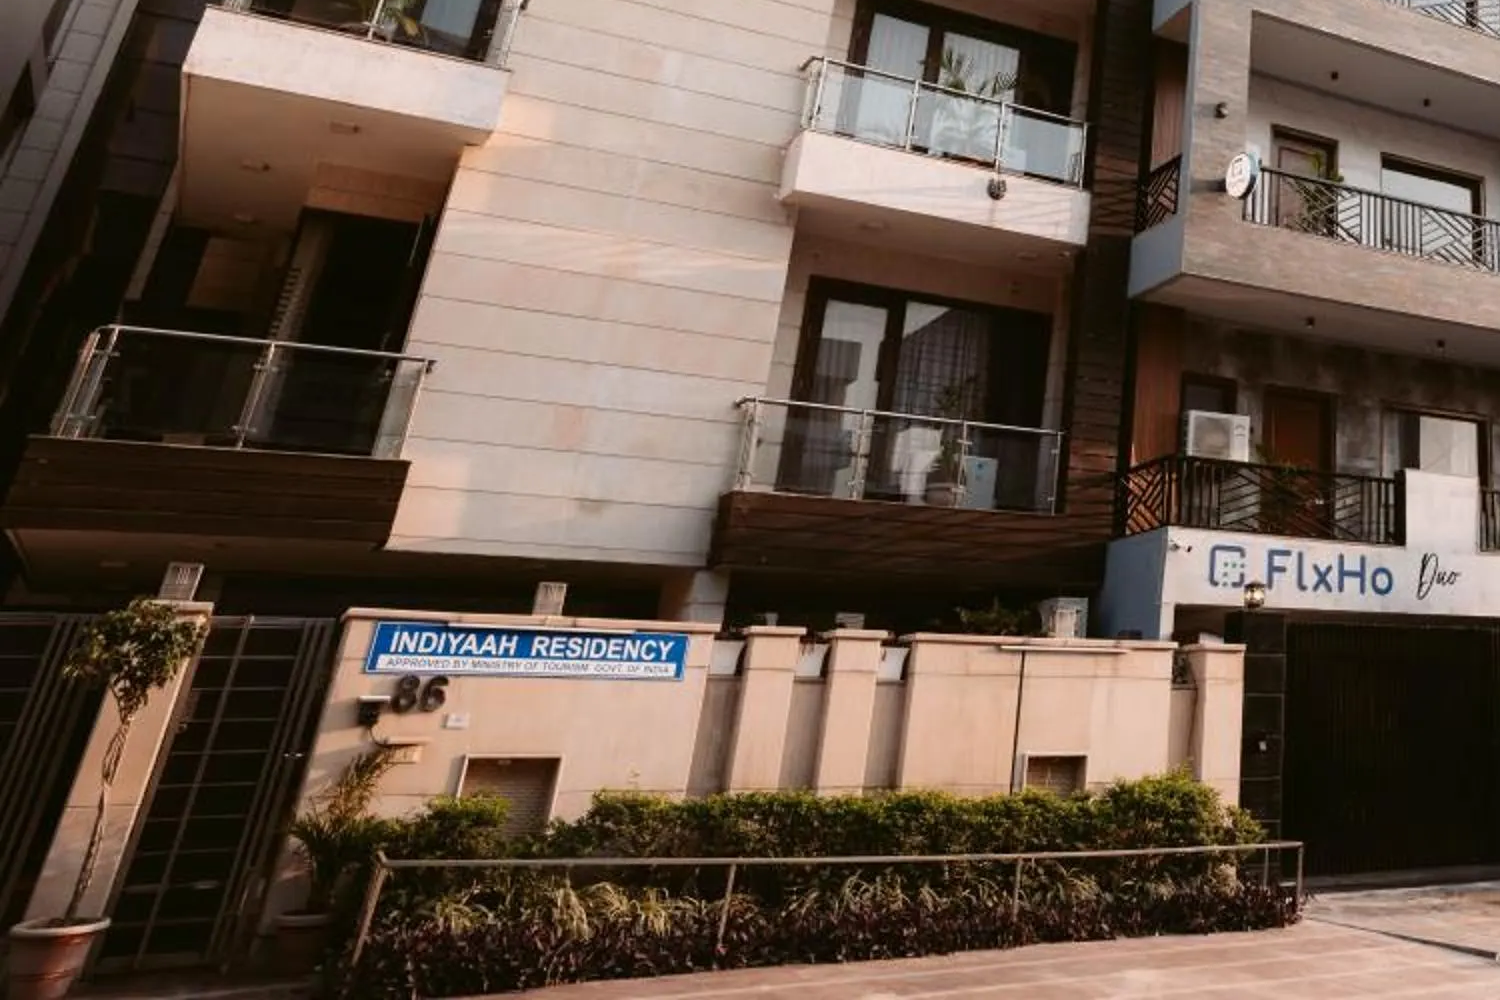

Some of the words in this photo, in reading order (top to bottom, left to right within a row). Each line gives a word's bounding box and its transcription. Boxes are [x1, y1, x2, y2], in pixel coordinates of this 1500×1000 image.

[1267, 549, 1394, 596] FlxHo
[1417, 552, 1461, 600] Duo
[390, 631, 519, 656] INDIYAAH
[531, 636, 674, 660] RESIDENCY
[387, 657, 450, 668] APPROVED
[454, 659, 468, 669] BY
[471, 660, 521, 671] MINISTRY
[523, 661, 537, 672] OF
[543, 662, 589, 673] TOURISM
[391, 674, 449, 713] 86
